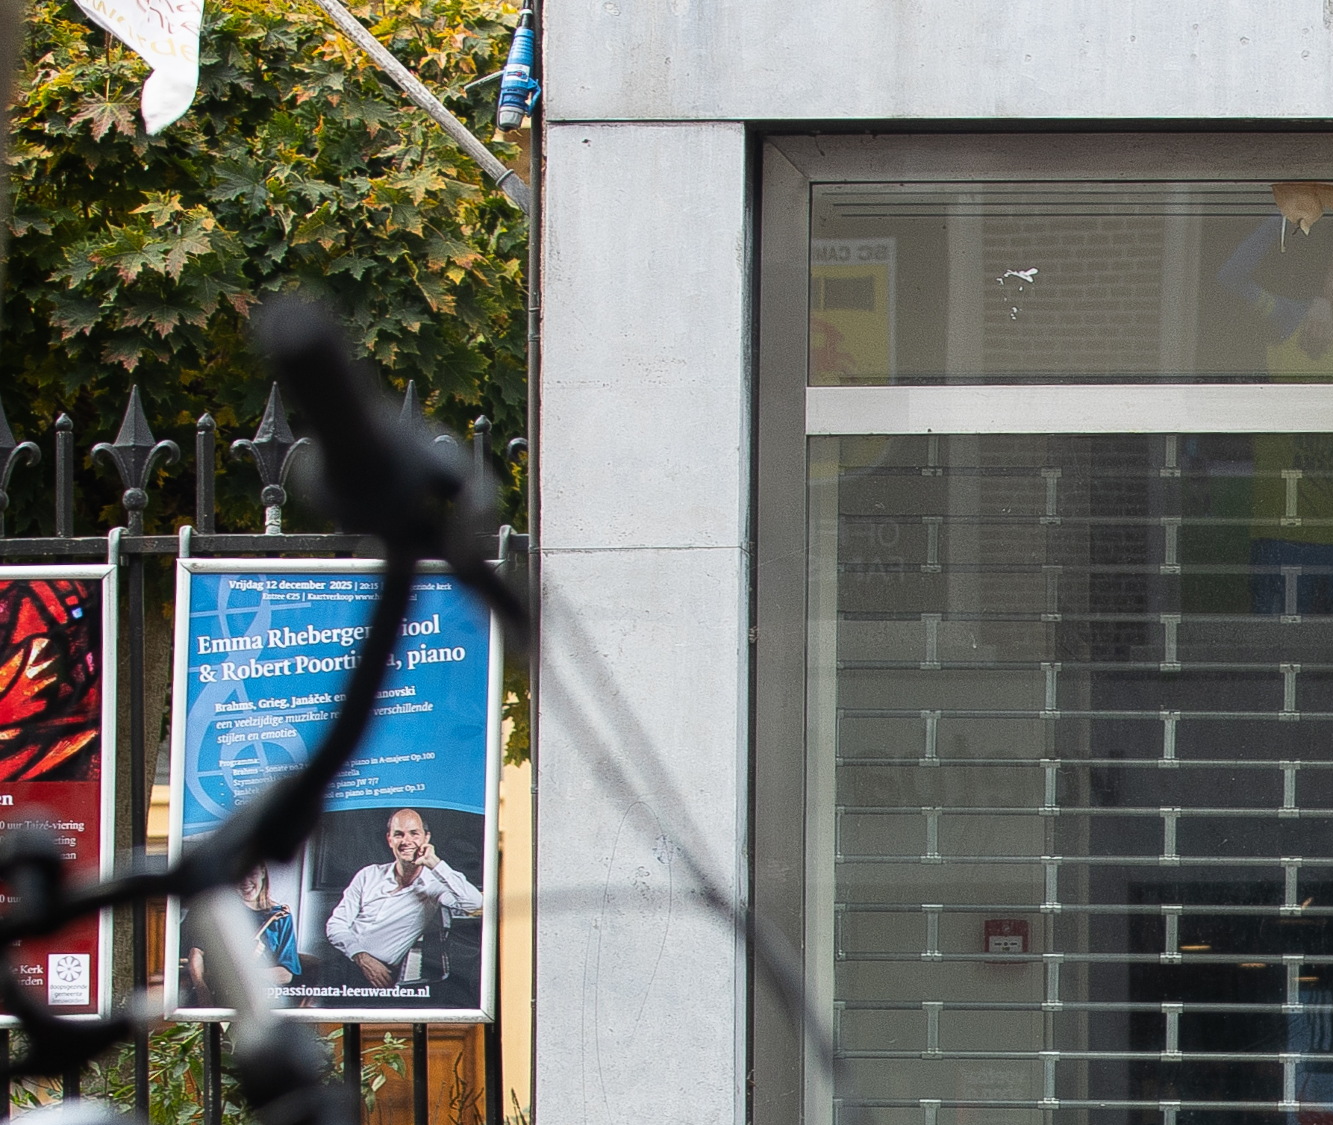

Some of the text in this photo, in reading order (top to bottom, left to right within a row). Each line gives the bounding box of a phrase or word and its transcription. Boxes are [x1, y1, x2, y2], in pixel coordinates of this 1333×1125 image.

[229, 580, 264, 591] Vrijdag
[266, 581, 277, 589] 12
[279, 580, 326, 590] december
[330, 581, 352, 590] 2025
[197, 633, 263, 655] Emma
[401, 614, 440, 637] iool
[199, 666, 217, 683] &
[221, 659, 291, 682] Robert
[406, 644, 466, 670] piano
[215, 702, 257, 713] Brahms,
[258, 698, 290, 709] Grieg,
[290, 694, 332, 708] Janáček
[216, 720, 233, 730] een
[234, 716, 284, 729] veelzijdige
[285, 711, 329, 723] muzikale
[373, 702, 434, 716] verschillende
[217, 729, 298, 745] stijlen en emoties
[20, 964, 44, 975] Kerk
